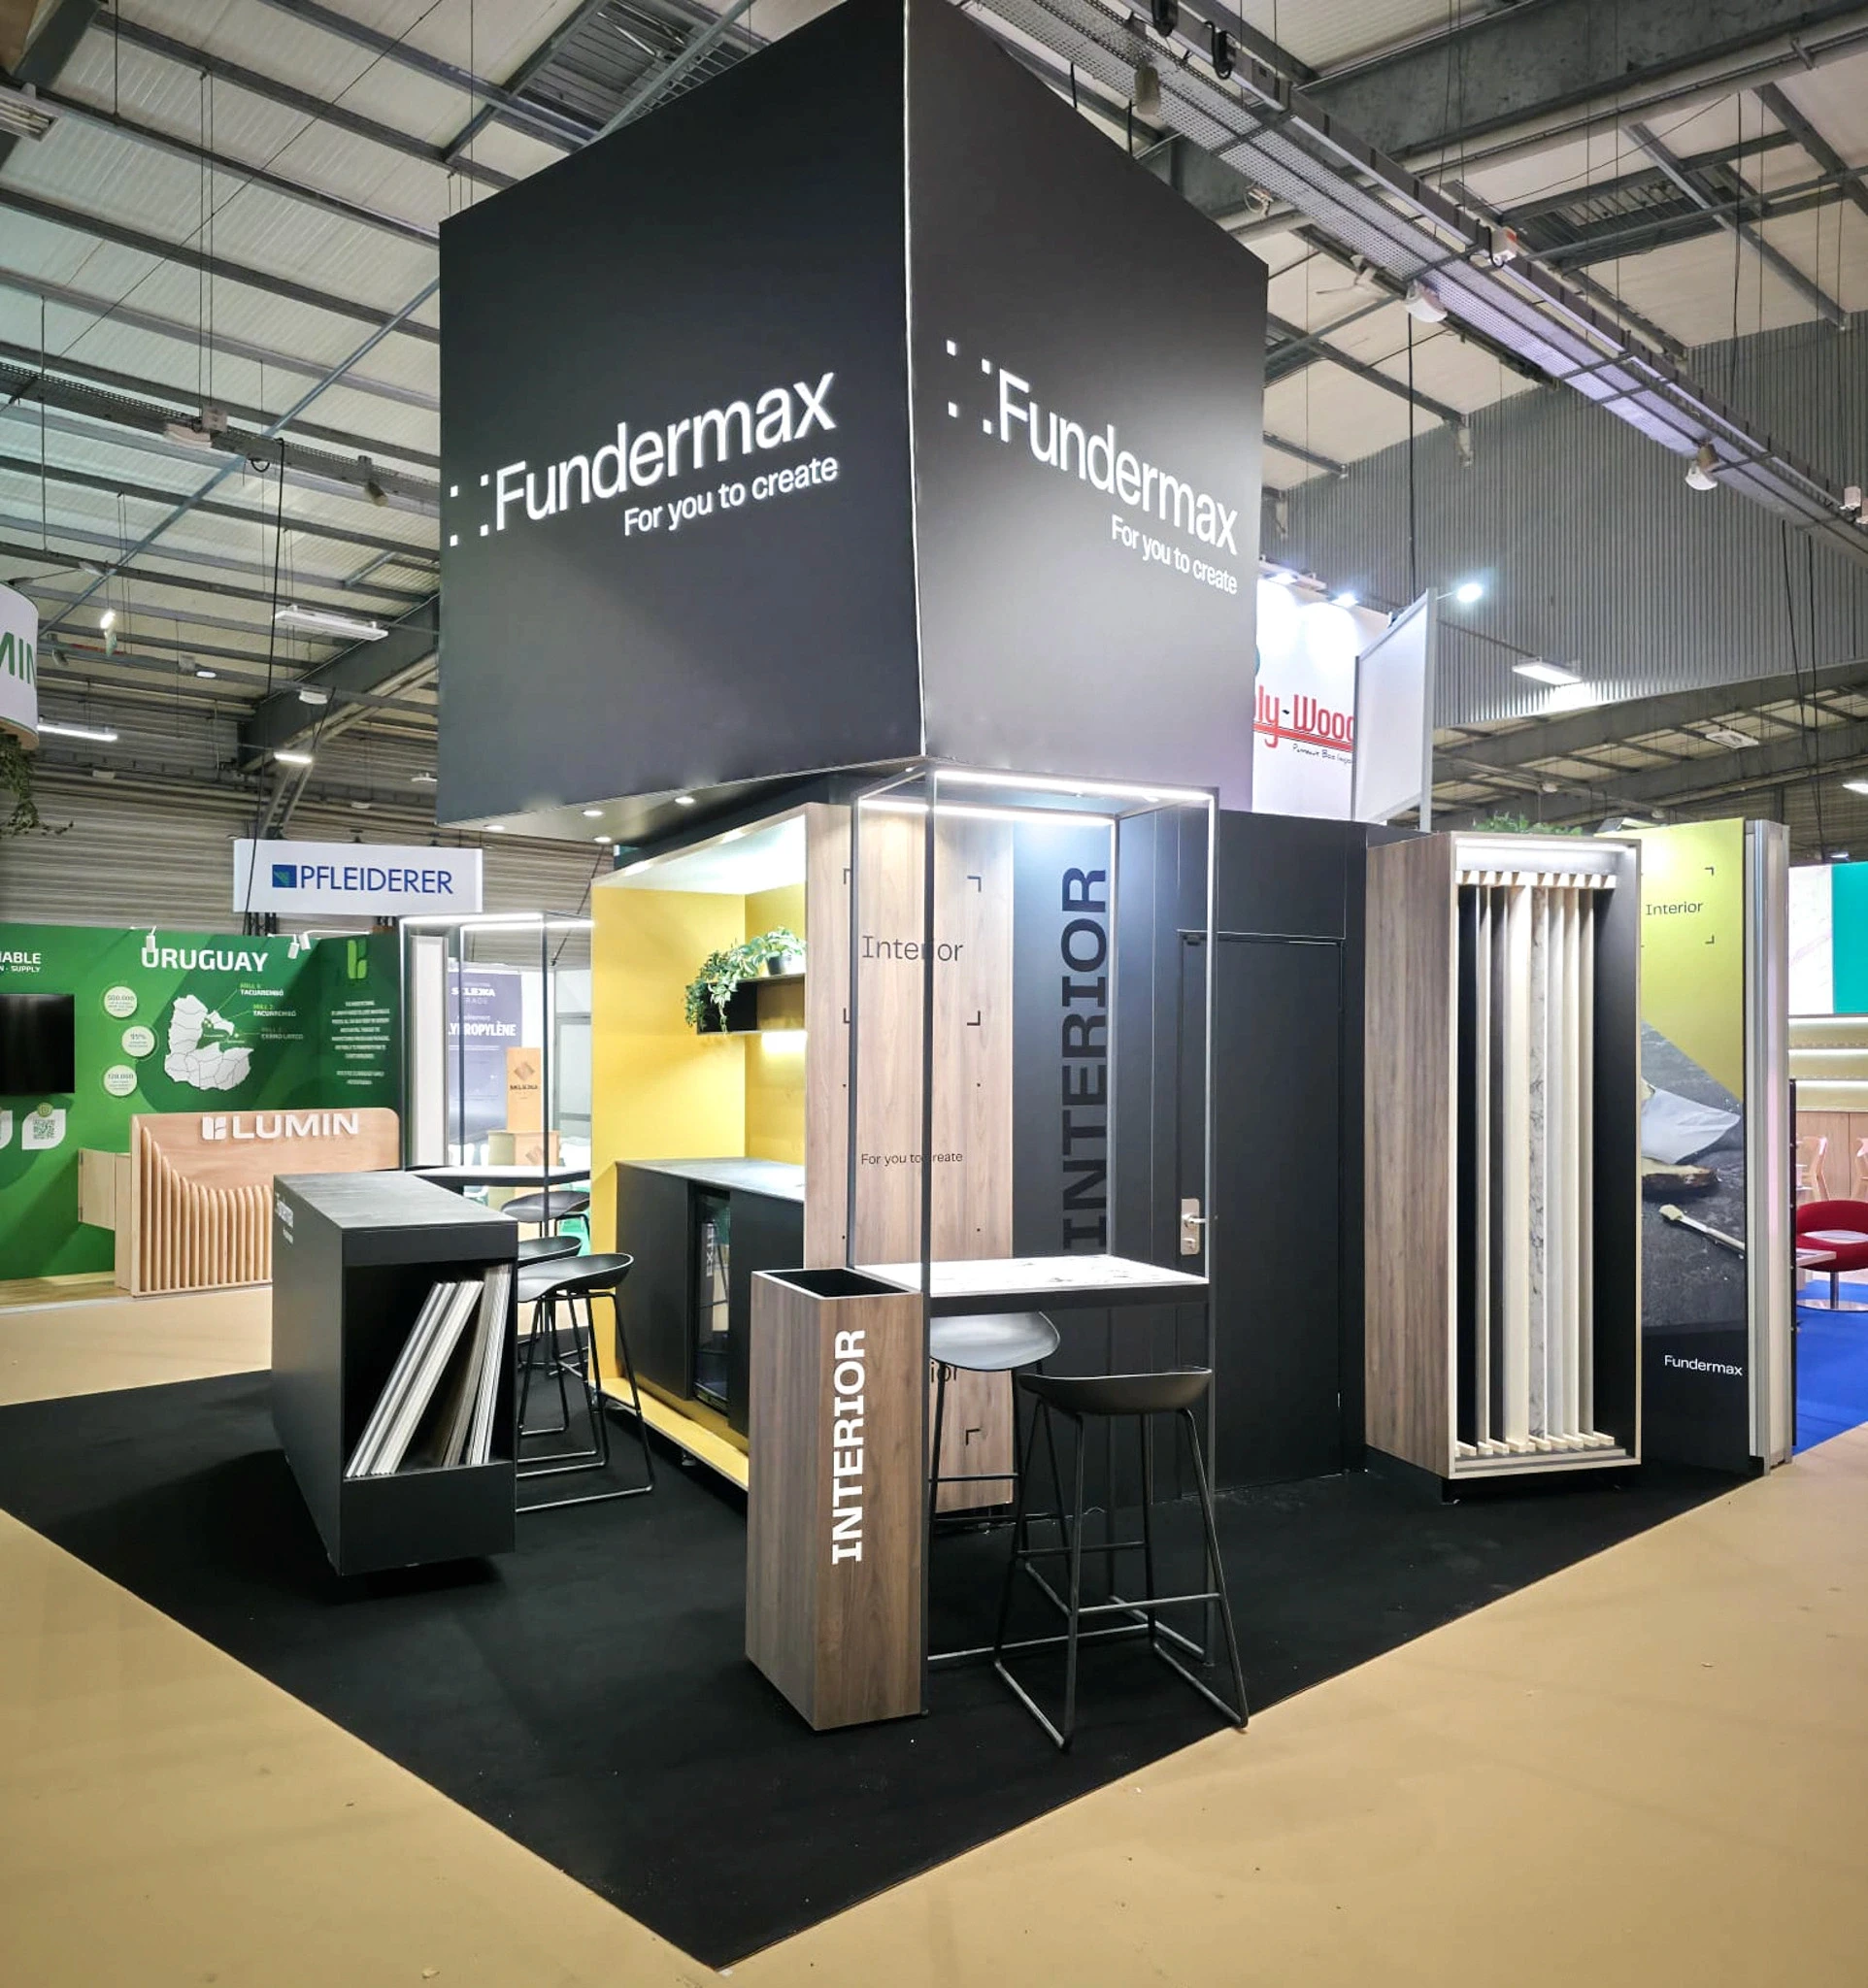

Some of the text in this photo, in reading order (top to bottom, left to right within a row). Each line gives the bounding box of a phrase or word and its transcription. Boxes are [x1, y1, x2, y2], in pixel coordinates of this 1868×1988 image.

[496, 372, 836, 531] Fundermax
[999, 368, 1239, 556] Fundermax
[624, 455, 839, 537] For you to create
[1112, 514, 1238, 595] For you to create
[301, 865, 453, 894] PFLEIDERER
[1646, 901, 1704, 915] Interior
[142, 947, 268, 972] URUGUAY
[862, 936, 963, 961] Inteor
[1060, 867, 1107, 1250] INTERIOR
[232, 1112, 360, 1139] LUMIN
[861, 1152, 963, 1167] For you to reate
[1664, 1355, 1744, 1376] Fundermax
[832, 1329, 866, 1565] INTERIOR
